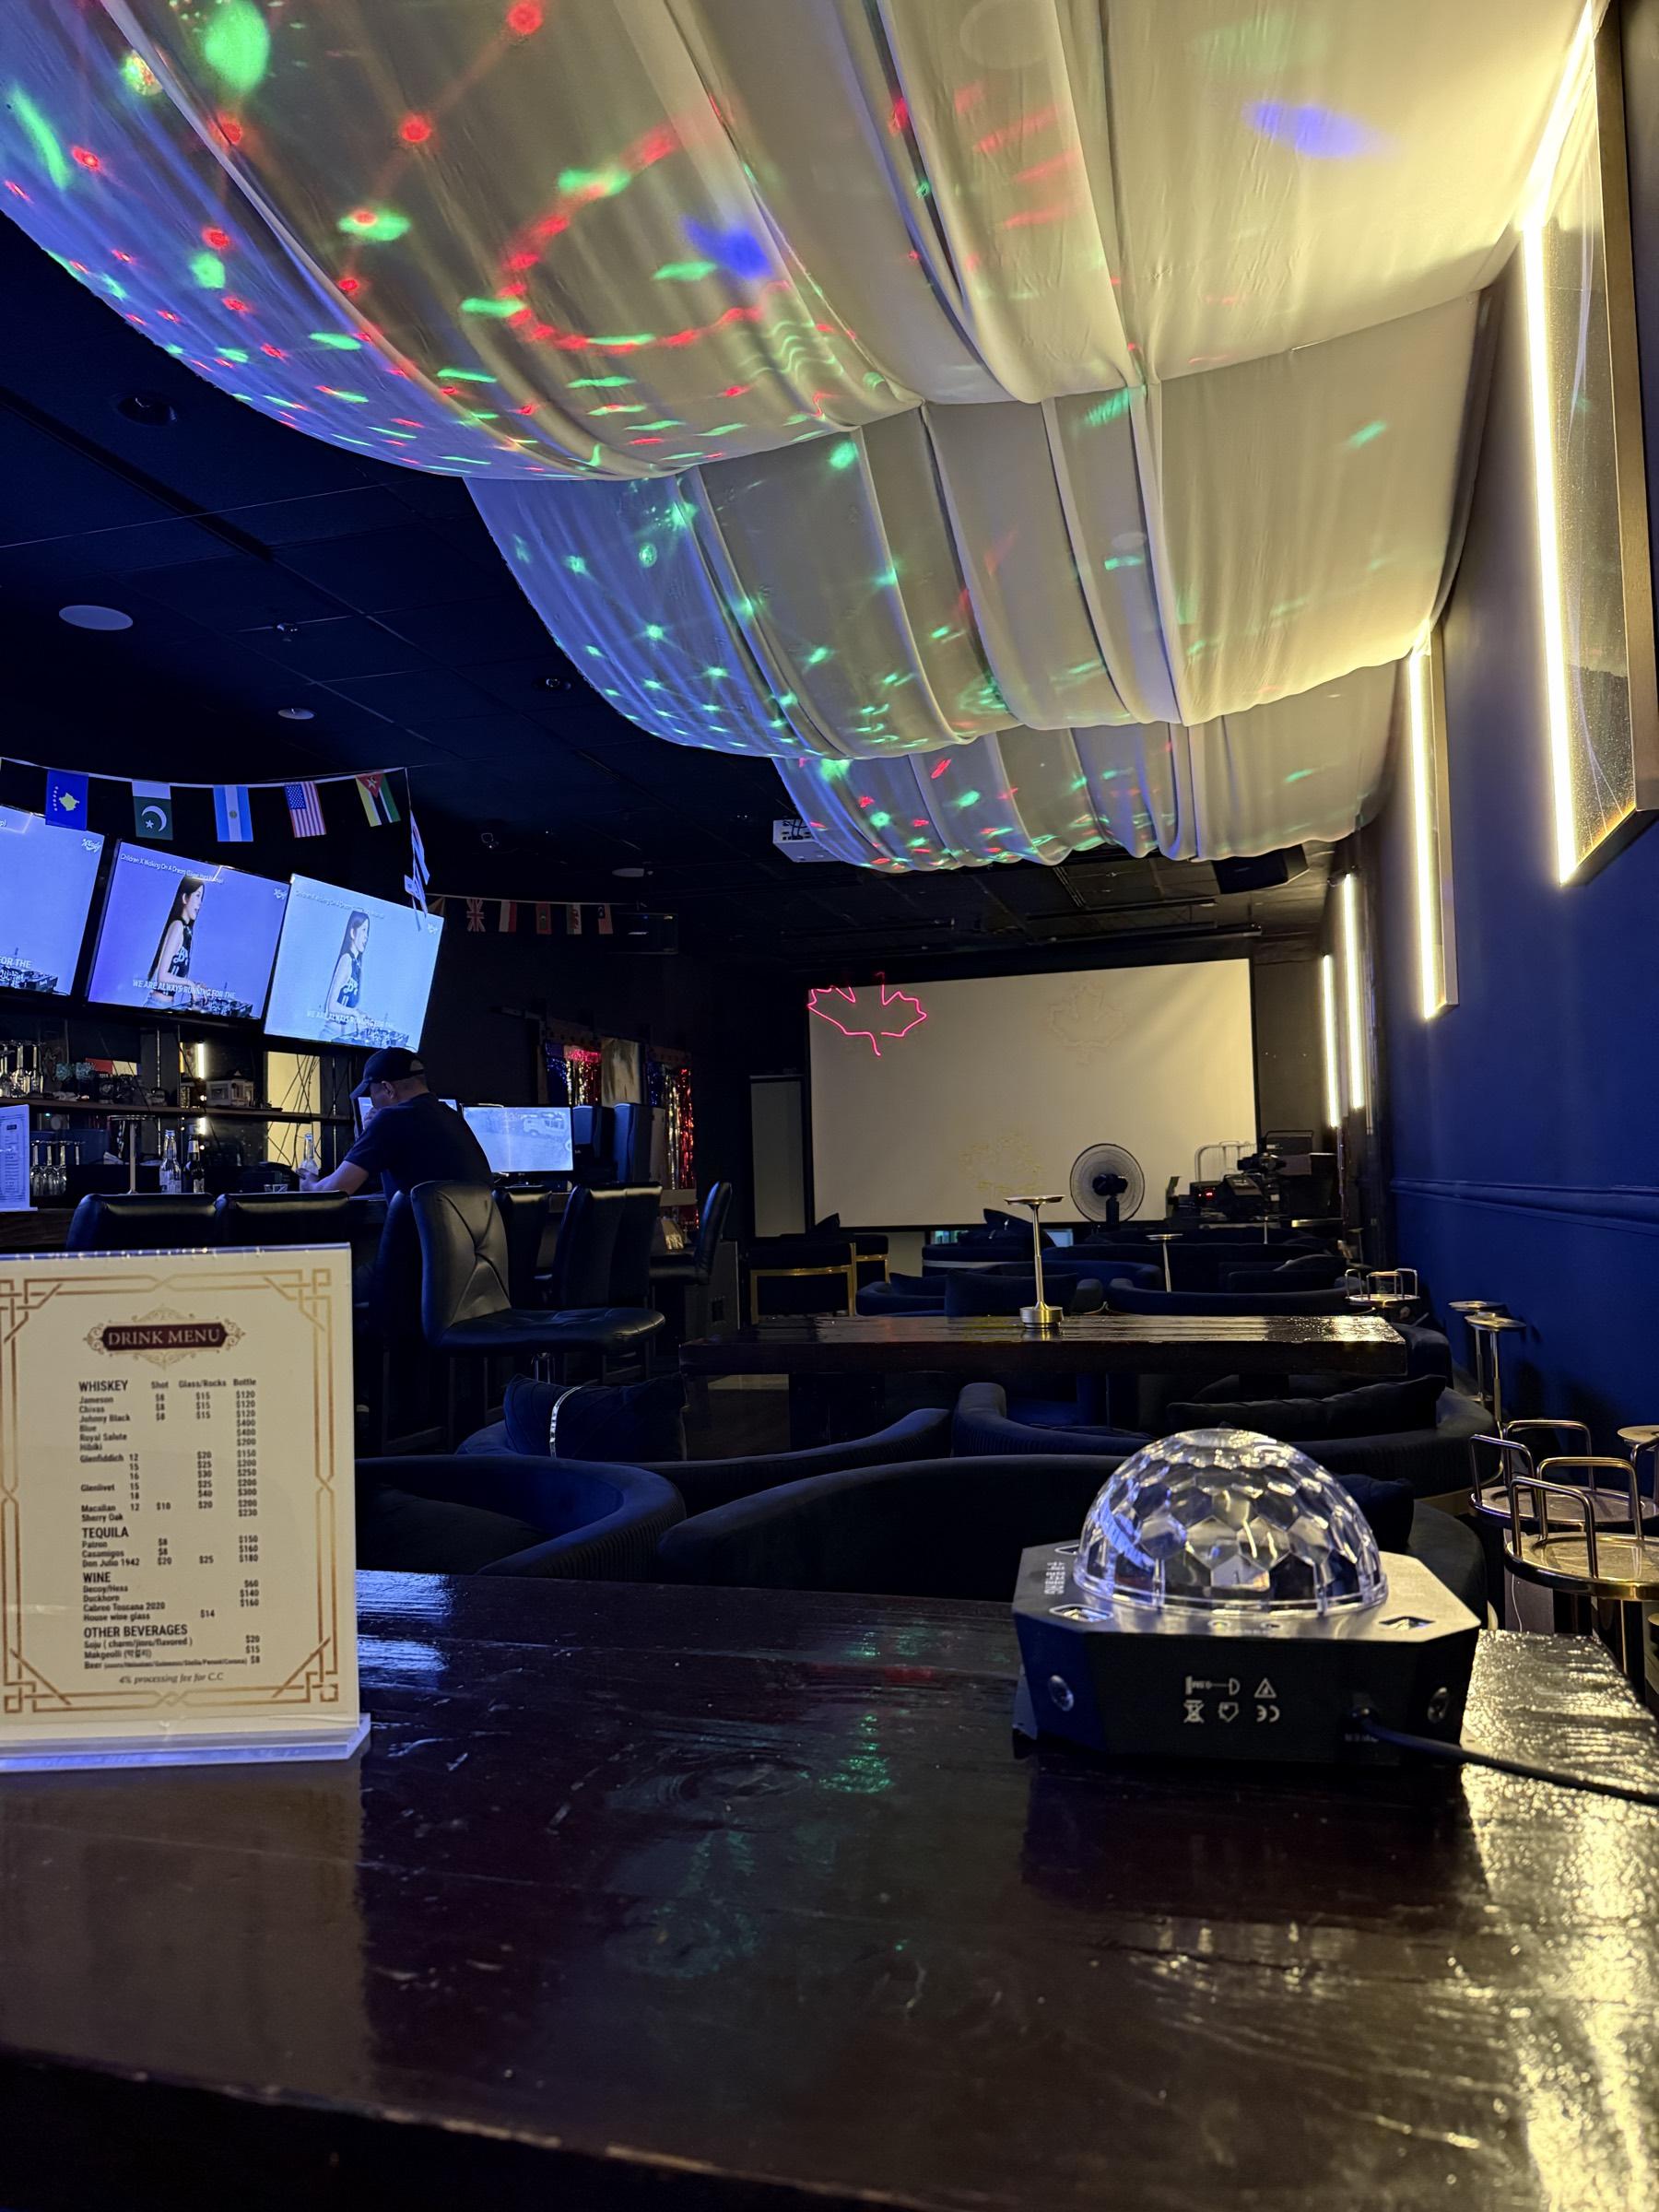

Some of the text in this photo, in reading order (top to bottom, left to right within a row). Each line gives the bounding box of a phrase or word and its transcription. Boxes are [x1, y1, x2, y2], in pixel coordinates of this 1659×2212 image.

[15, 959, 31, 969] THE
[146, 981, 157, 989] ARE
[158, 982, 182, 993] ALWAYS
[182, 985, 209, 996] RUNNING
[109, 1329, 220, 1345] DRINK MENU
[79, 1380, 128, 1392] WHISKEY
[151, 1381, 169, 1389] Shot
[196, 1392, 210, 1400] $15
[236, 1391, 255, 1399] $120
[237, 1400, 255, 1408] $120
[79, 1415, 107, 1423] Johnny
[196, 1411, 210, 1419] $15
[237, 1409, 255, 1418] $120
[237, 1419, 255, 1428] $400
[80, 1434, 100, 1442] Royal
[237, 1429, 256, 1437] $400
[237, 1438, 256, 1446] $200
[80, 1453, 124, 1462] Glenfiddich
[197, 1451, 212, 1459] $20
[237, 1449, 256, 1457] $150
[237, 1458, 257, 1467] $200
[238, 1468, 257, 1477] $250
[198, 1488, 213, 1498] $40
[131, 1503, 139, 1512] 12
[157, 1502, 171, 1511] $10
[198, 1500, 213, 1509] $20
[81, 1514, 106, 1523] Sherry
[109, 1512, 124, 1521] Oak
[82, 1526, 129, 1539] TEQUILA
[82, 1540, 108, 1548] Patron
[239, 1535, 258, 1543] $150
[82, 1550, 124, 1559] Casamigos
[82, 1559, 98, 1568] Don
[100, 1559, 118, 1567] Julio
[121, 1558, 140, 1566] 1942
[158, 1556, 172, 1566] $20
[199, 1555, 214, 1564] $25
[83, 1571, 111, 1583] WINE
[146, 1602, 165, 1610] 2020
[84, 1613, 108, 1621] House
[129, 1613, 150, 1622] glass
[200, 1609, 215, 1618] $14
[84, 1624, 188, 1638] OTHER BEVERAGES
[84, 1641, 101, 1649] Soju
[245, 1634, 260, 1643] $20
[245, 1644, 260, 1653] $15
[84, 1660, 102, 1669] Beer
[134, 1674, 178, 1685] processing
[179, 1673, 193, 1683] fee
[194, 1673, 206, 1682] for
[207, 1671, 224, 1681] C.C
